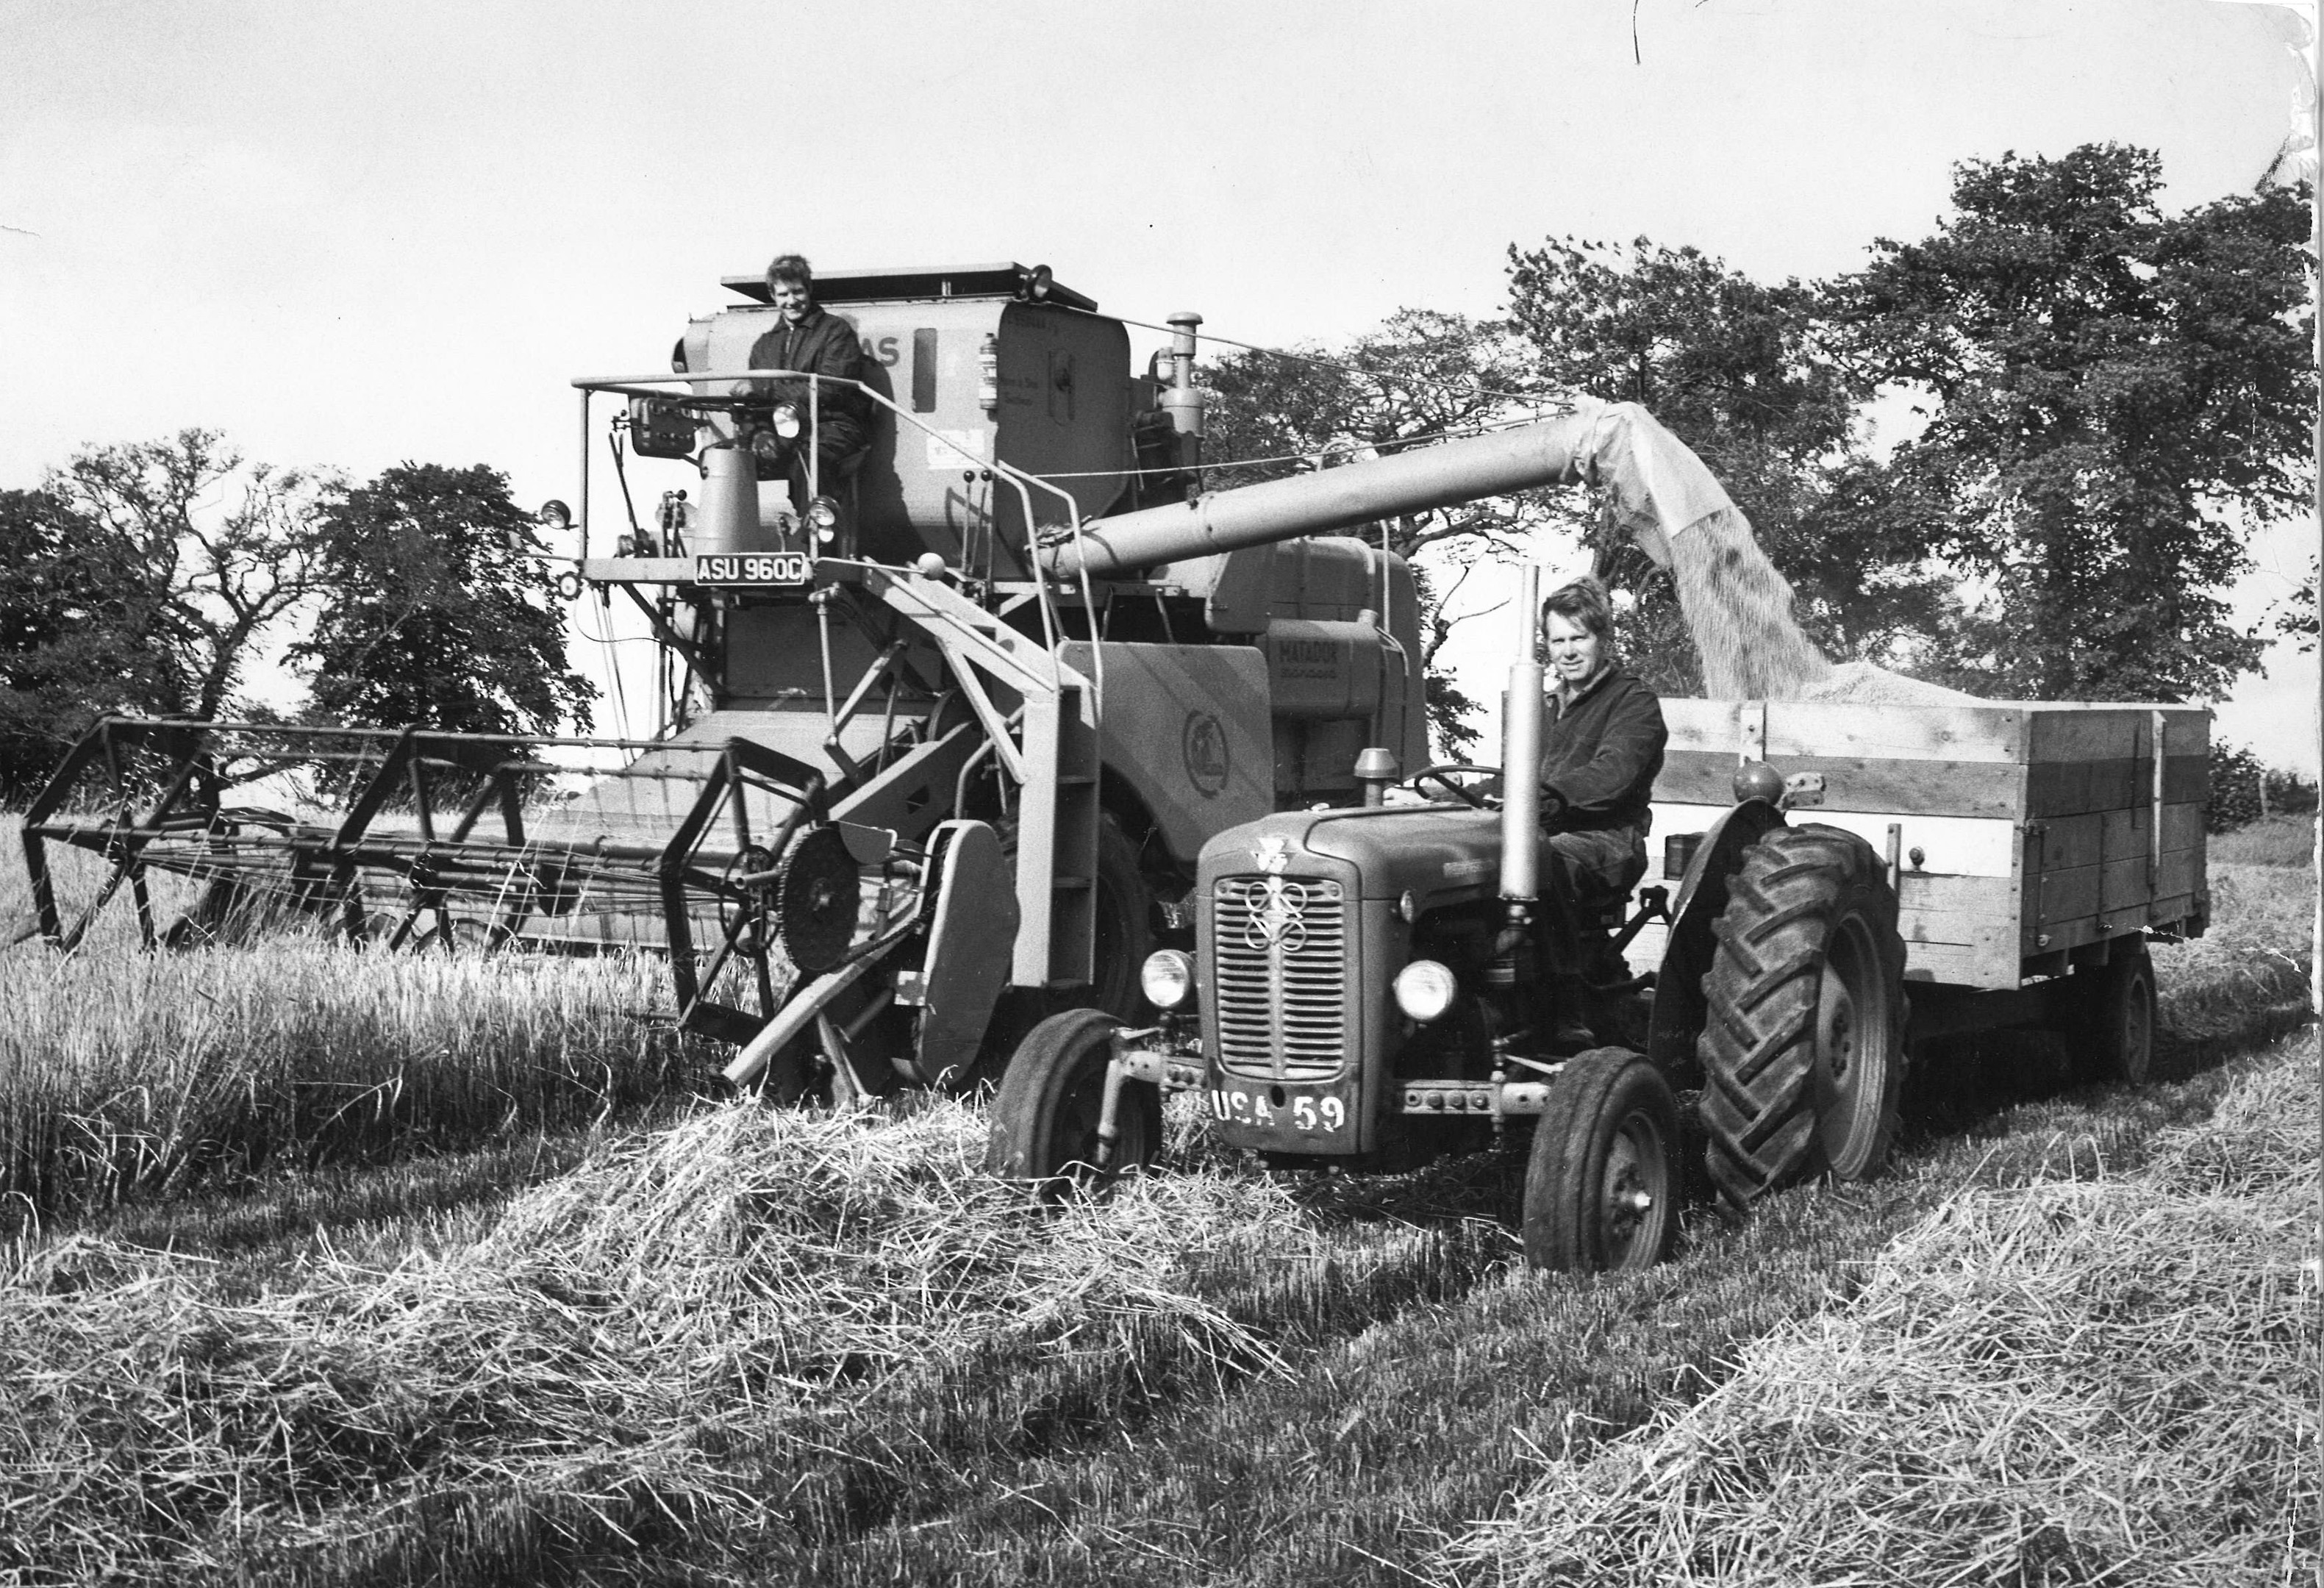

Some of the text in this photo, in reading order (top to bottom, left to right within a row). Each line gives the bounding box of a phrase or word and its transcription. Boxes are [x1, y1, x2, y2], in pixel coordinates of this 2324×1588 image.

[698, 557, 802, 580] ASU 960C
[1212, 1090, 1345, 1133] USA 59
